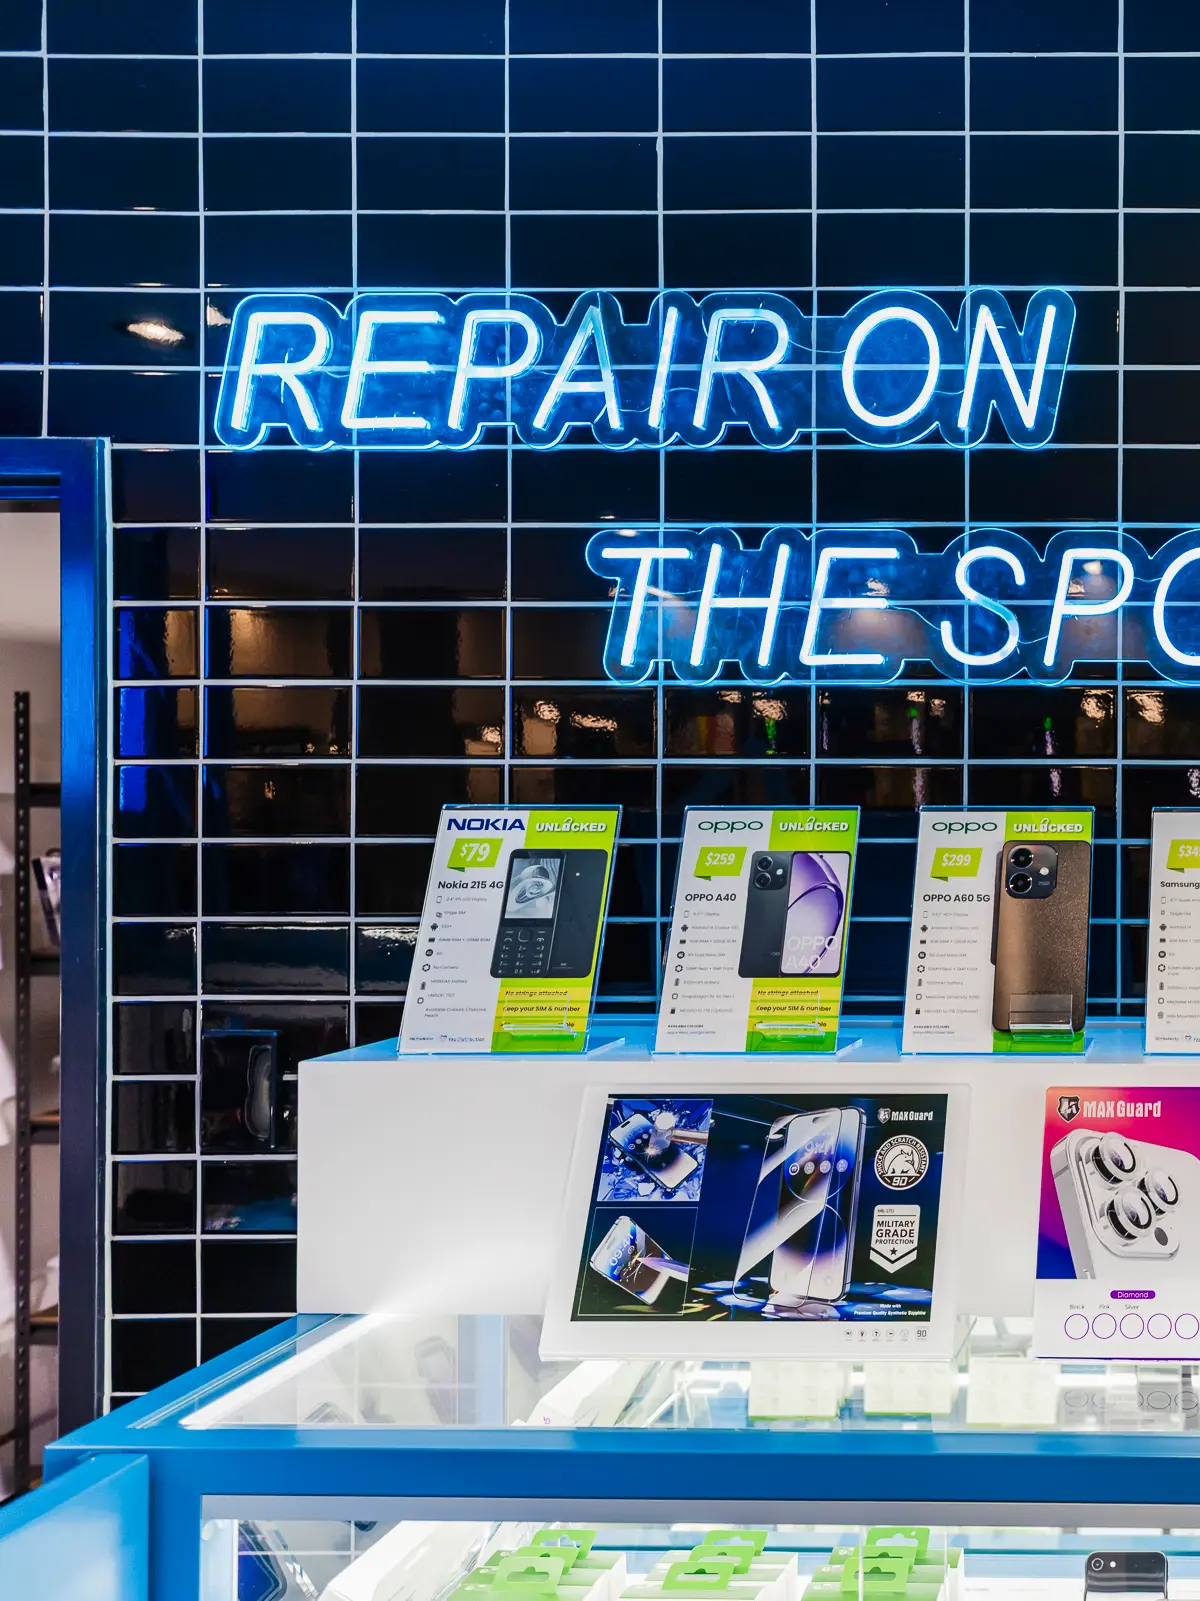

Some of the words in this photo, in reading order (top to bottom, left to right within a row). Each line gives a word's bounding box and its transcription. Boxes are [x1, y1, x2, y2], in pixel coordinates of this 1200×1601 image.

[228, 306, 795, 436] REPAIR
[838, 302, 1057, 428] ON
[600, 546, 902, 668] THE
[447, 818, 526, 831] NOKIA
[535, 818, 607, 832] UNLOCKED
[779, 817, 849, 832] UNLOCKED
[1013, 818, 1083, 833] UNLOCKED
[459, 842, 491, 862] $79
[705, 852, 735, 866] $259
[941, 853, 971, 867] $299
[437, 880, 469, 889] Nokia
[470, 881, 487, 889] 215
[489, 881, 504, 889] 4G
[1160, 880, 1200, 890] Samsung
[685, 893, 713, 902] OPPO
[715, 893, 737, 902] A40
[923, 894, 951, 902] OPPO
[953, 894, 974, 902] A60
[976, 894, 991, 902] 5G
[787, 935, 837, 951] OPPO
[891, 1137, 918, 1146] SCRATCH
[876, 1220, 916, 1228] MILITARY
[876, 1229, 915, 1238] GRADE
